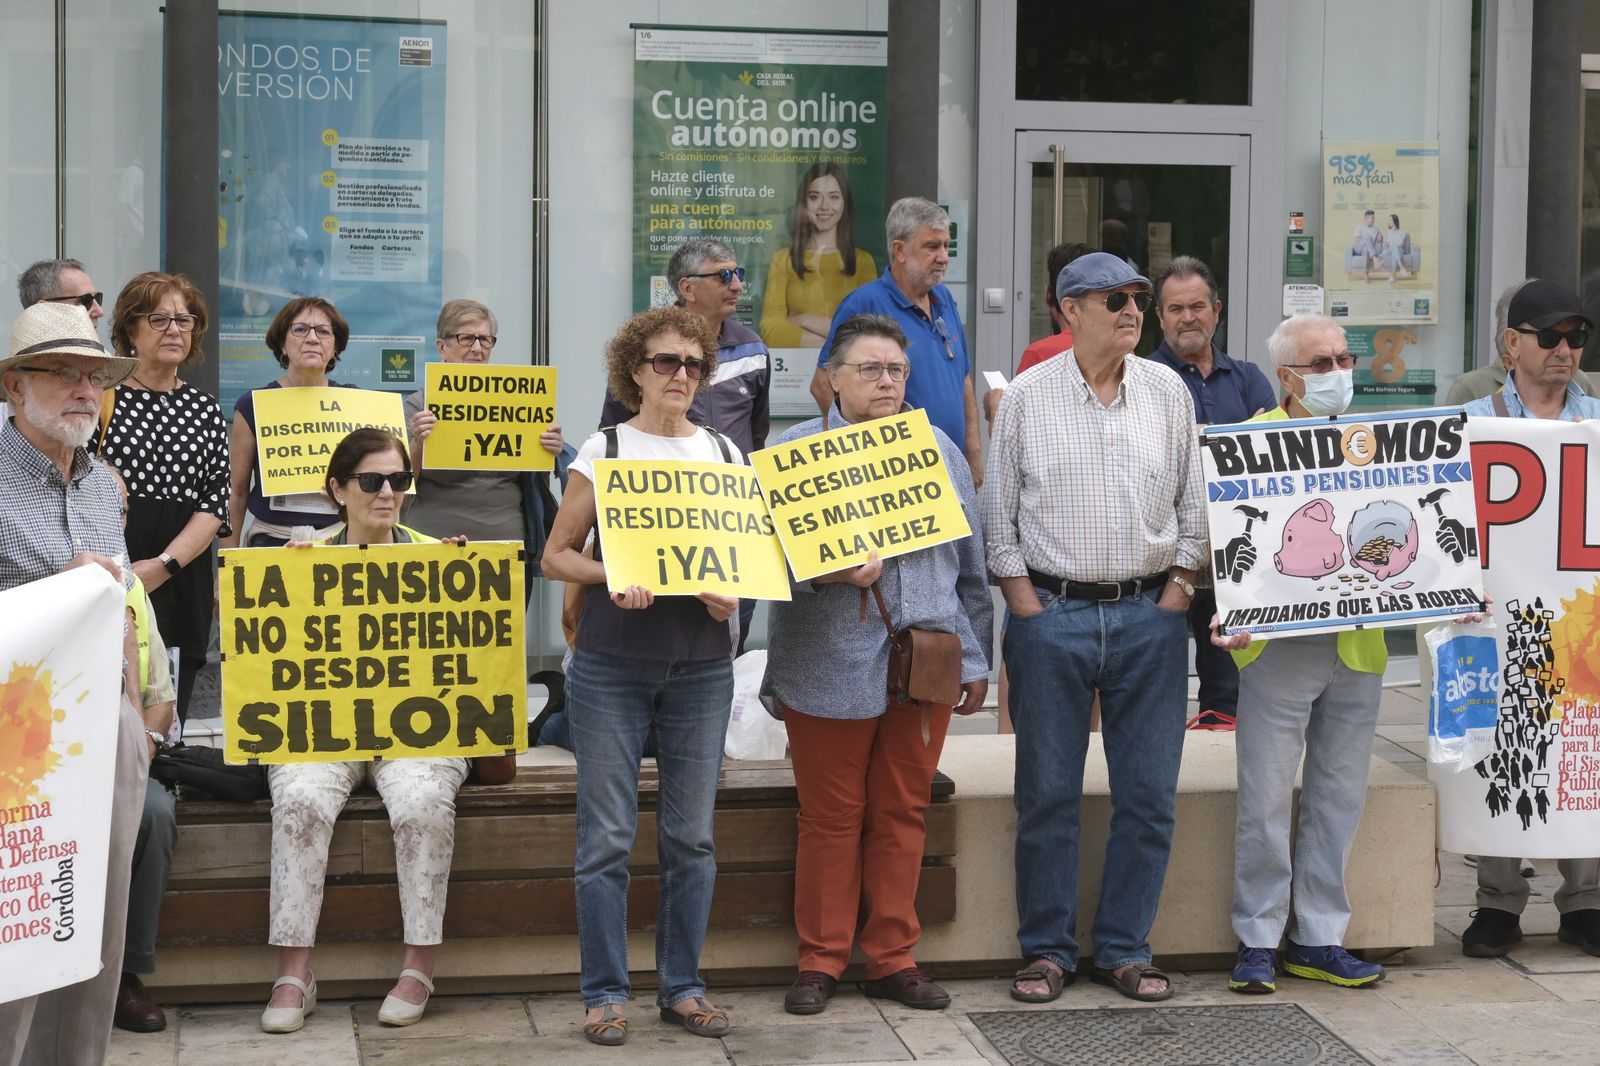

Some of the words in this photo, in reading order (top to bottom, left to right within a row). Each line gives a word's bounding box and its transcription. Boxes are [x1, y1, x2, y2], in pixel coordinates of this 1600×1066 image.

[640, 31, 652, 40] 1/6
[218, 43, 320, 71] NDOS
[331, 47, 371, 73] DE
[651, 89, 767, 121] Cuenta
[778, 91, 877, 123] online
[671, 119, 857, 149] autónomos
[660, 151, 674, 161] Sin
[322, 175, 335, 183] 02
[651, 170, 689, 183] Hazte
[692, 170, 735, 183] cliente
[1365, 170, 1394, 188] fácil
[650, 184, 691, 197] online
[694, 188, 702, 200] y
[705, 184, 756, 198] disfruta
[758, 185, 775, 198] de
[650, 204, 679, 215] una
[683, 203, 736, 215] cuenta
[650, 219, 685, 232] para
[689, 215, 774, 231] autónomos
[650, 235, 666, 244] que
[667, 235, 688, 243] pone
[732, 236, 765, 245] negocio,
[774, 358, 789, 372] 3.
[438, 374, 547, 395] AUDITORIA
[320, 400, 341, 412] LA
[428, 403, 553, 424] RESIDENCIAS
[265, 445, 303, 459] POR
[308, 442, 331, 456] LA
[464, 433, 522, 462] ¡YA!
[772, 448, 808, 473] LA
[808, 429, 878, 463] FALTA
[879, 420, 912, 445] DE
[606, 469, 764, 501] AUDITORIA
[769, 447, 940, 509] ACCESIBILIDAD
[1251, 474, 1295, 497] LAS
[1303, 465, 1431, 494] PENSIONES
[605, 506, 775, 537] RESIDENCIAS
[787, 512, 819, 537] ES
[821, 481, 942, 528] MALTRATO
[818, 542, 836, 564] A
[837, 533, 869, 558] LA
[867, 514, 940, 549] VEJEZ
[657, 545, 740, 586] ¡YA!
[233, 564, 290, 609] LA
[313, 551, 512, 607] PENSIÓN
[1226, 601, 1331, 627] IMPIDAMOS
[1336, 597, 1373, 618] QUE
[1377, 592, 1413, 614] LAS
[1417, 587, 1481, 608] ROBEN
[234, 616, 287, 654] NO
[304, 614, 342, 653] SE
[358, 609, 513, 651] DEFIENDE
[272, 655, 410, 691] DESDE
[432, 653, 479, 686] EL
[237, 689, 515, 754] SILLÓN
[1561, 699, 1600, 720] Plata
[1559, 718, 1600, 738] Ciuda
[1561, 740, 1588, 757] para
[1558, 755, 1577, 772] del
[9, 840, 78, 868] Defensa
[0, 897, 21, 919] co
[27, 886, 52, 912] de
[51, 856, 74, 942] Córdoba
